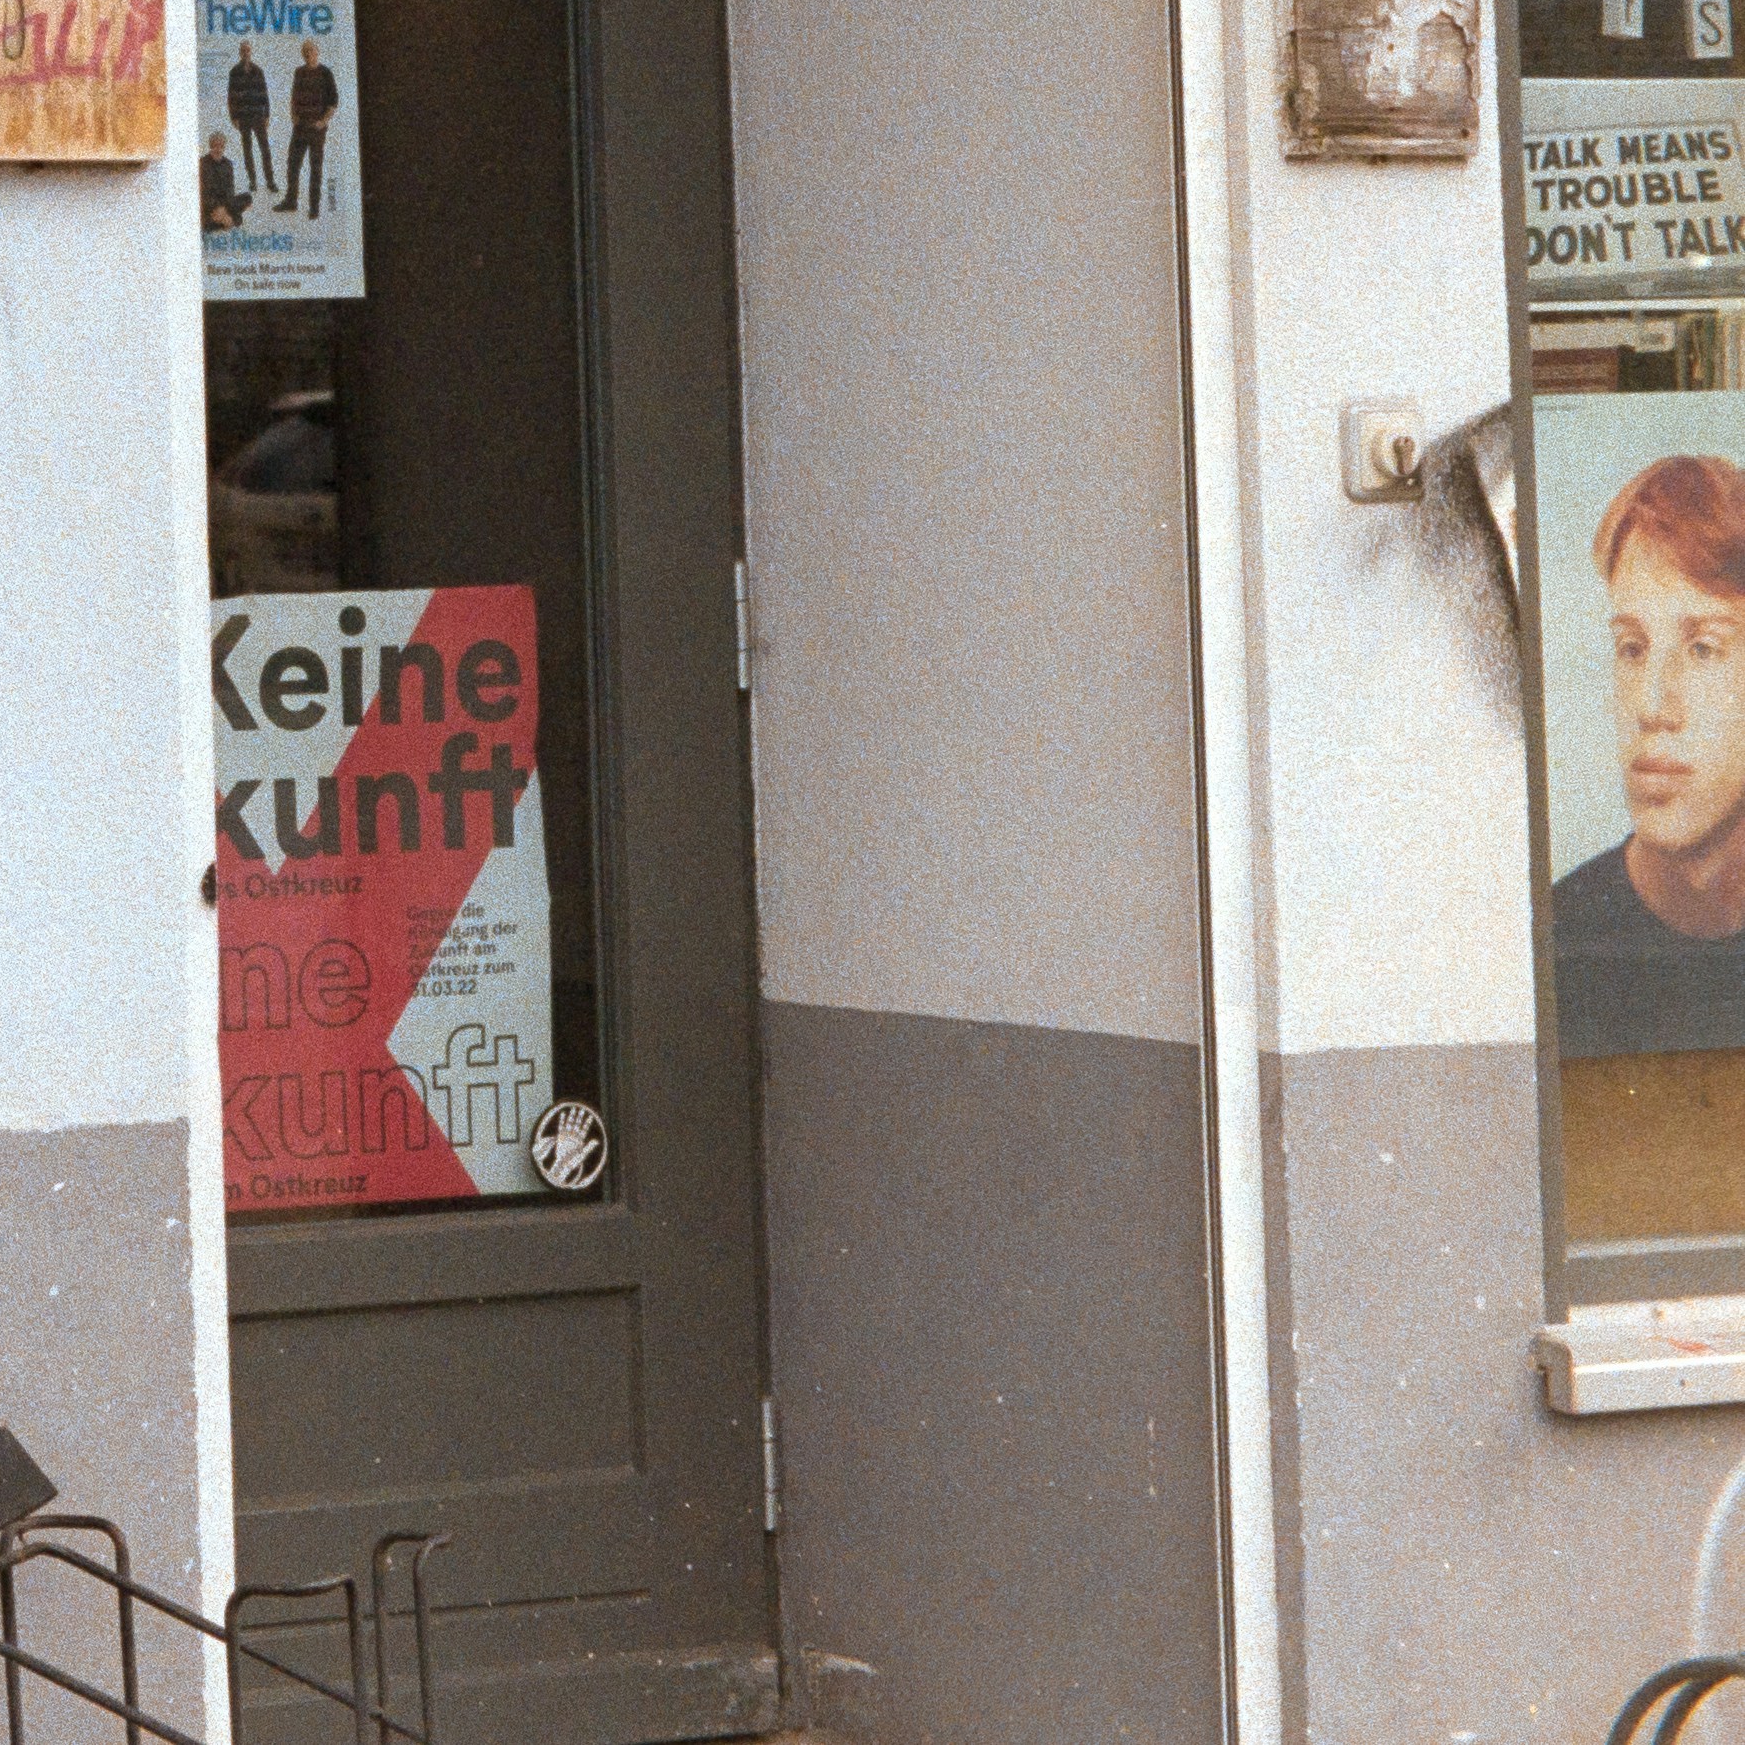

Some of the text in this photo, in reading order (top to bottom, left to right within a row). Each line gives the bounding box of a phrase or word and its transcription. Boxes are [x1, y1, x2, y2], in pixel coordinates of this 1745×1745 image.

[1522, 129, 1734, 173] TALK MEANS
[1532, 169, 1724, 211] TROUBLE
[1525, 214, 1745, 267] DON'T TALK
[244, 872, 365, 900] Ostkreuz
[250, 1172, 369, 1202] Ostkreuz
